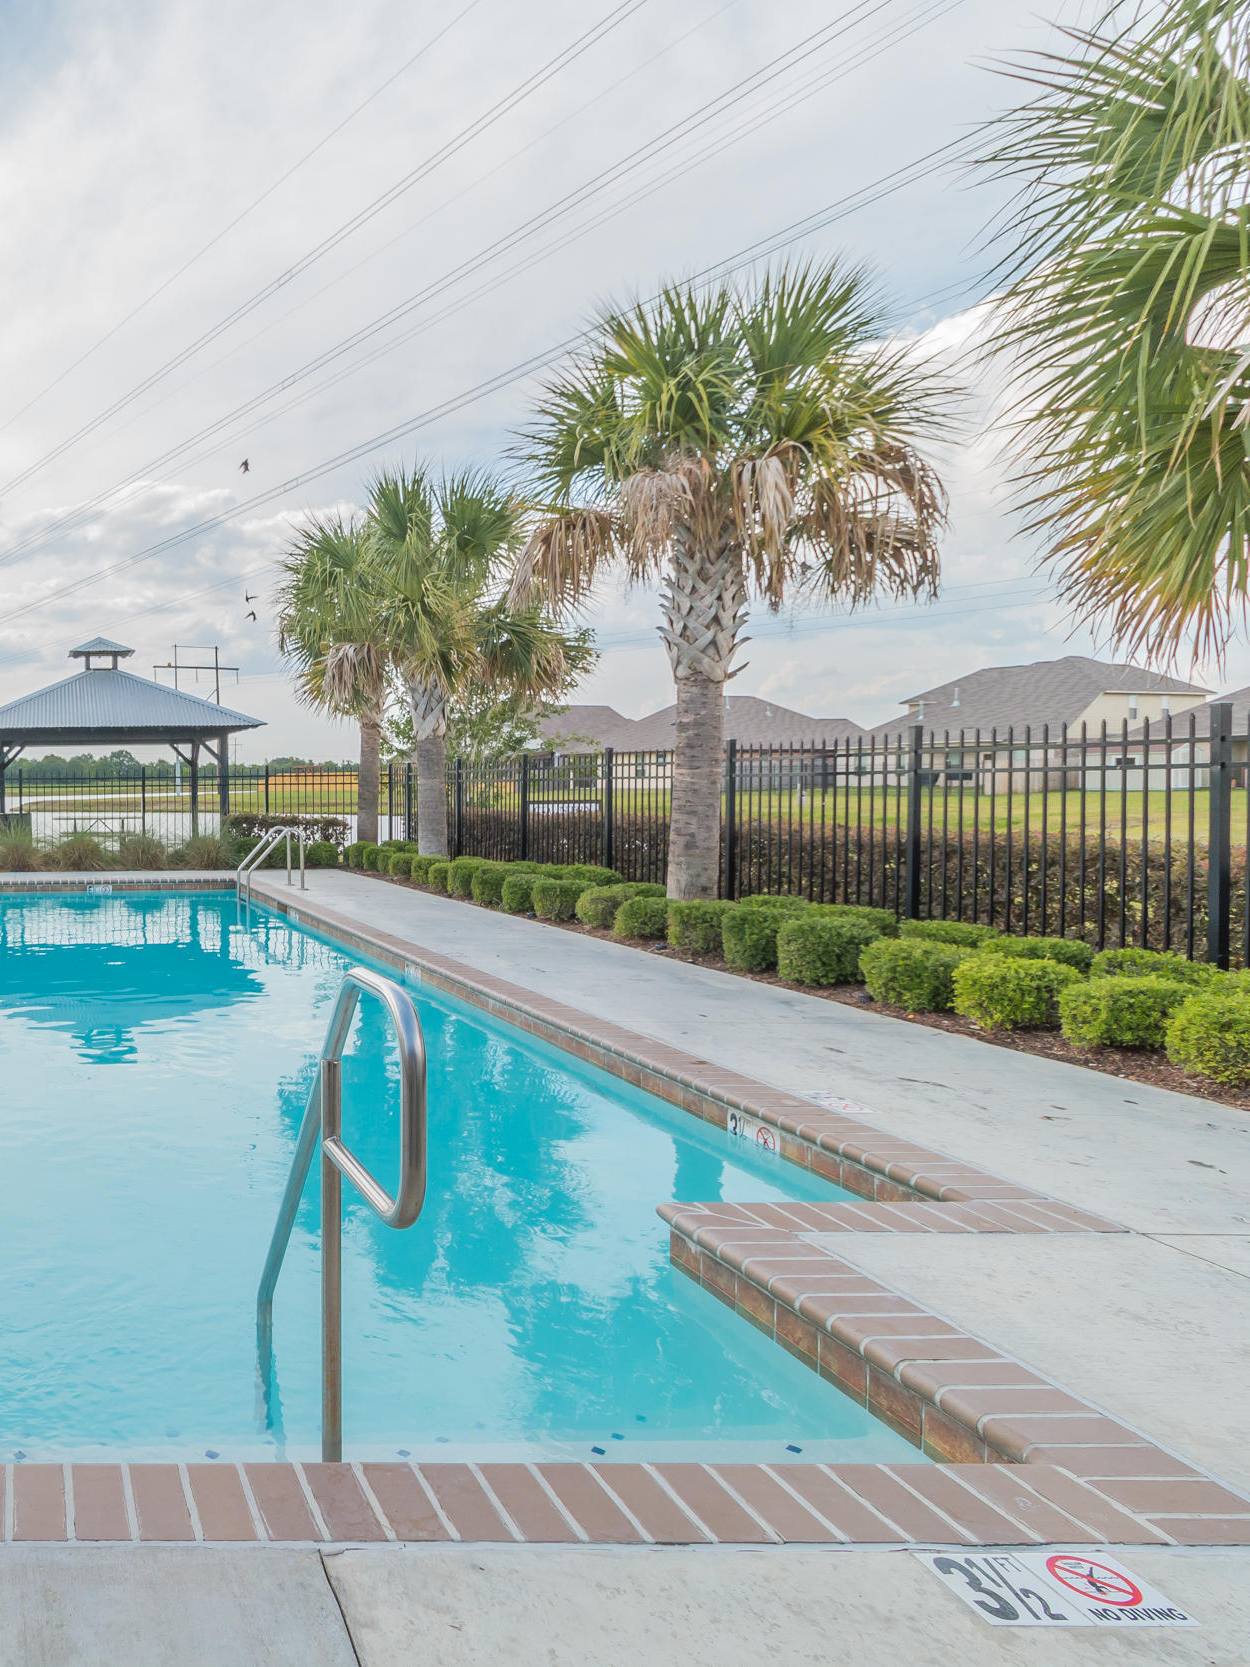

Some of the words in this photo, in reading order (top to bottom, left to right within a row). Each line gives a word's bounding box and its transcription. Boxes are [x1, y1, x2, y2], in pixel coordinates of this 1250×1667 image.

[992, 1557, 1022, 1572] FT
[1087, 1608, 1122, 1621] NO
[1117, 1608, 1188, 1621] DIVING
